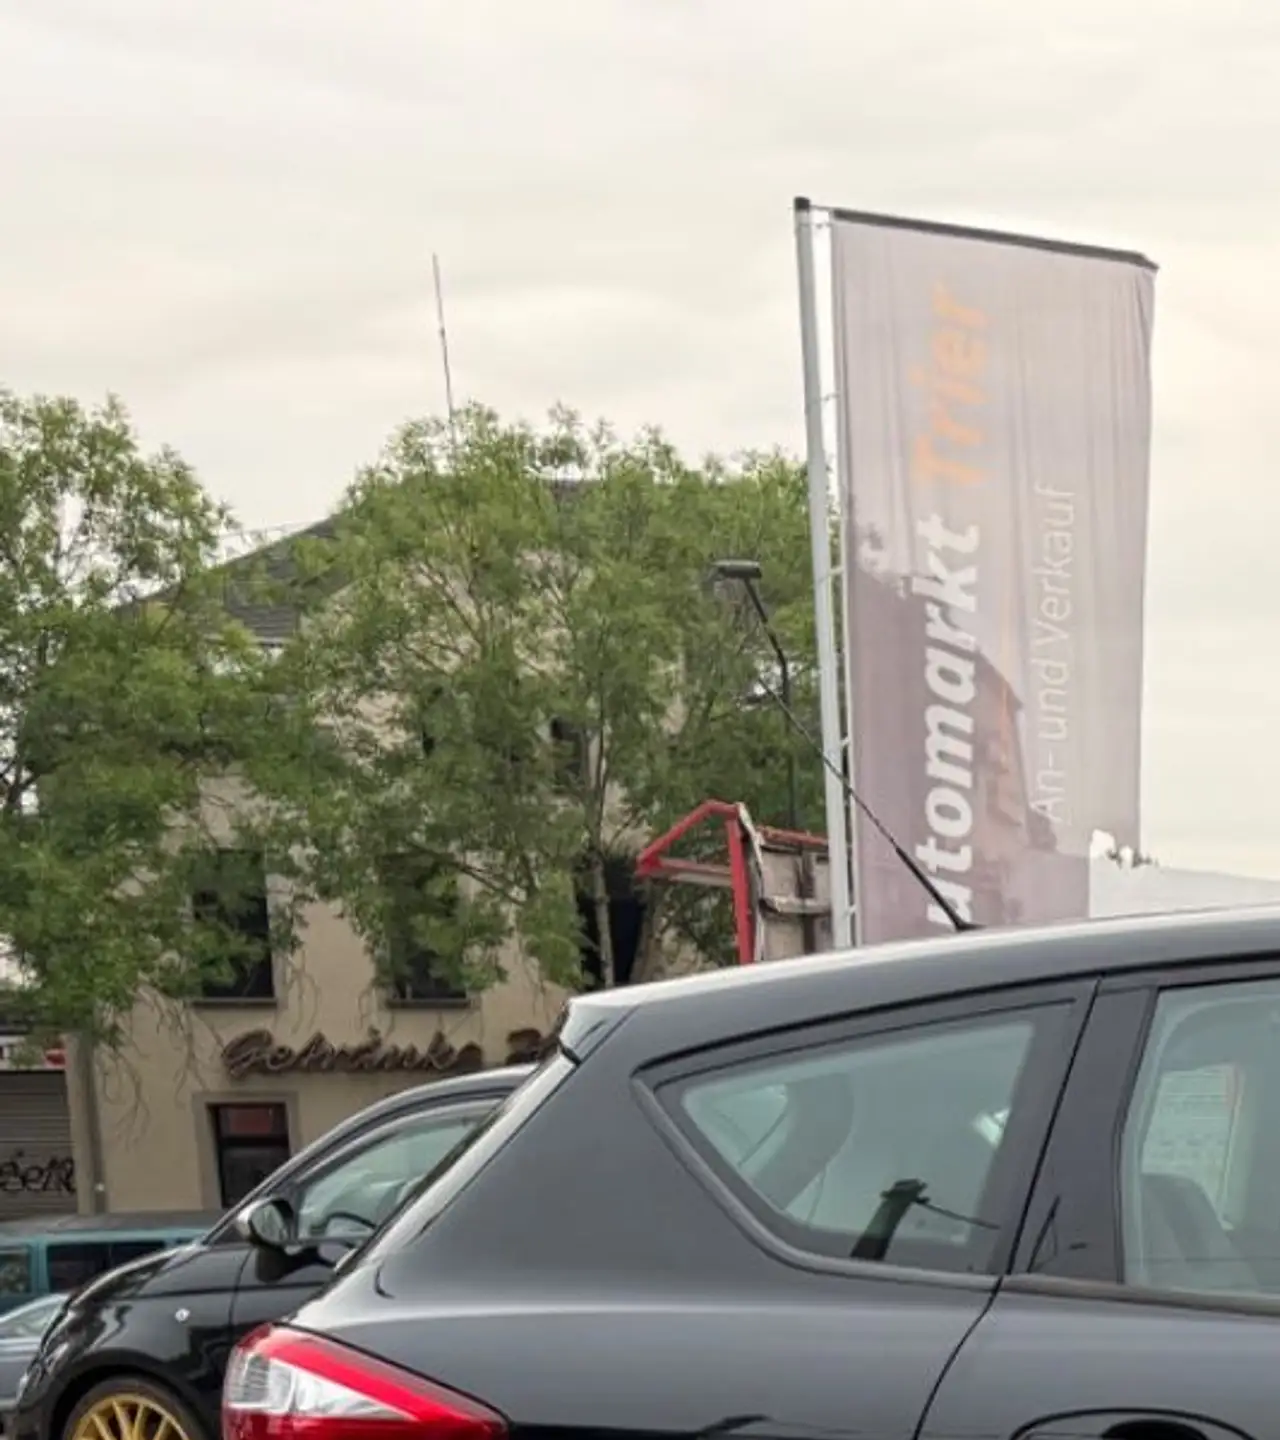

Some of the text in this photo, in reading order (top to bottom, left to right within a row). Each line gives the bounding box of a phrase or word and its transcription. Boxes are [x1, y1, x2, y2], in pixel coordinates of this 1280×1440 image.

[907, 281, 987, 930] utomarkt Trier
[1029, 481, 1075, 824] An- und Verkauf
